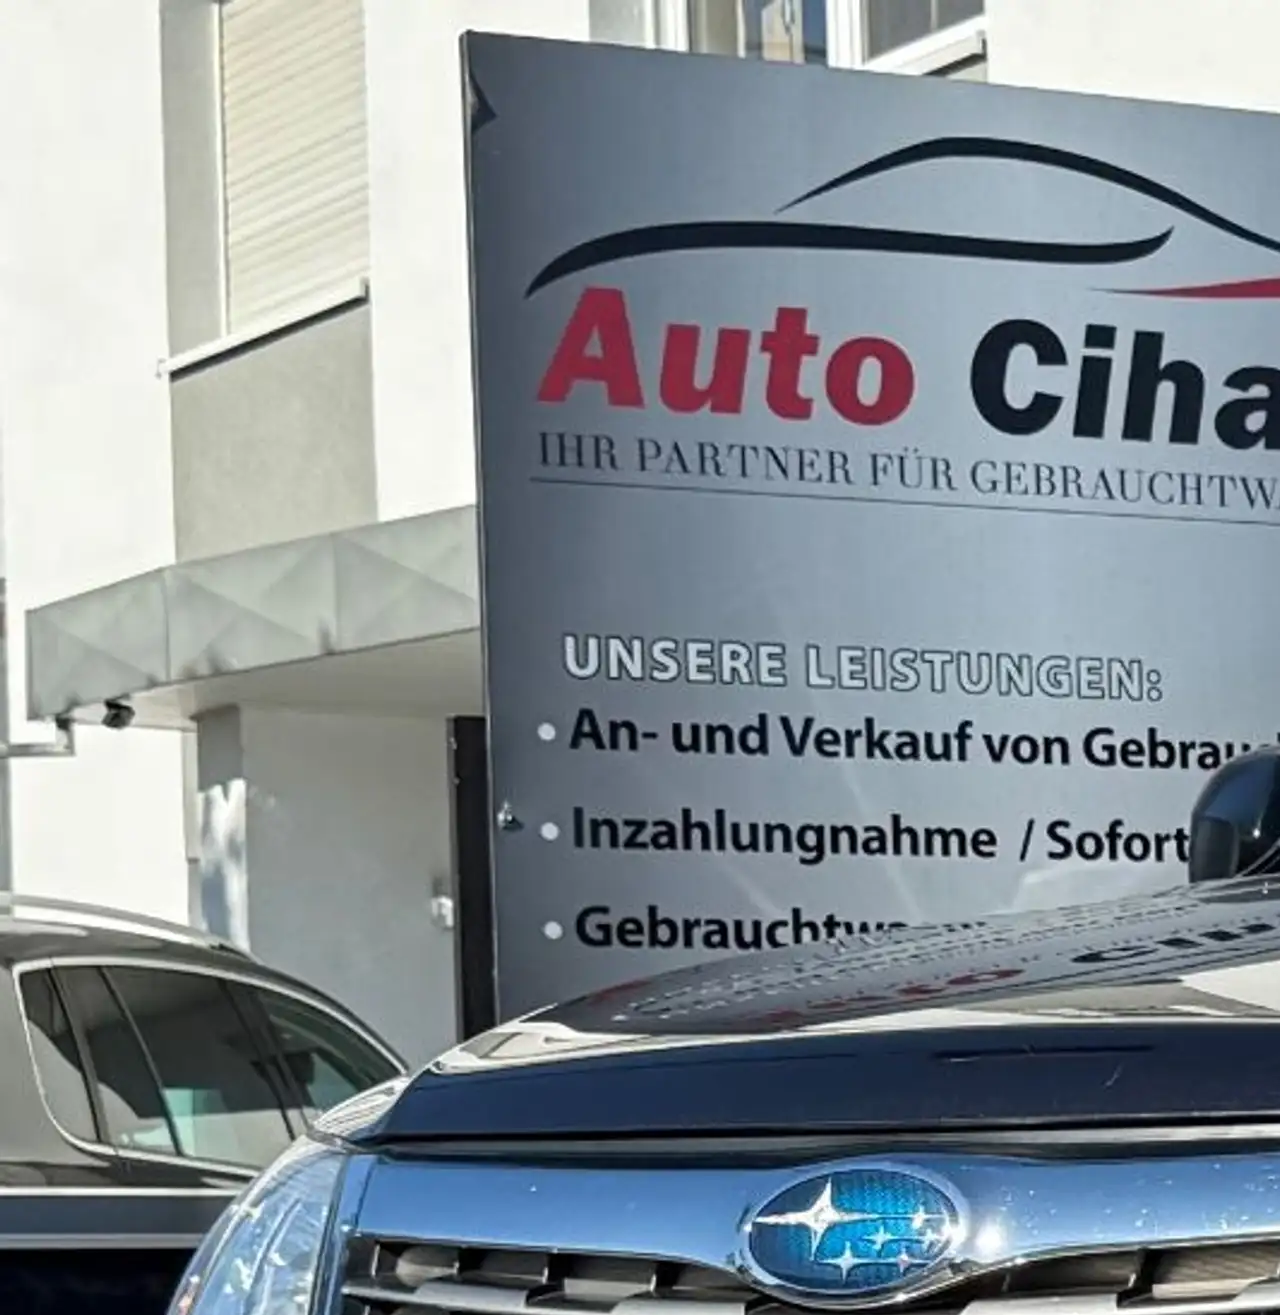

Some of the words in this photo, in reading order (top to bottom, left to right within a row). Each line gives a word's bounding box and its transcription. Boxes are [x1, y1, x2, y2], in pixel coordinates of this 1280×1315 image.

[537, 286, 915, 426] Auto
[538, 431, 617, 472] IHR
[636, 437, 854, 486] PARTNER
[870, 445, 963, 491] FÜR
[563, 633, 788, 687] UNSERE
[805, 644, 1162, 702] LEISTUNGEN:
[569, 707, 659, 751] An-
[671, 712, 769, 757] und
[779, 712, 973, 762] Verkauf
[983, 733, 1070, 765] von
[573, 806, 997, 866] Inzahlungnahme
[1018, 817, 1036, 862] /
